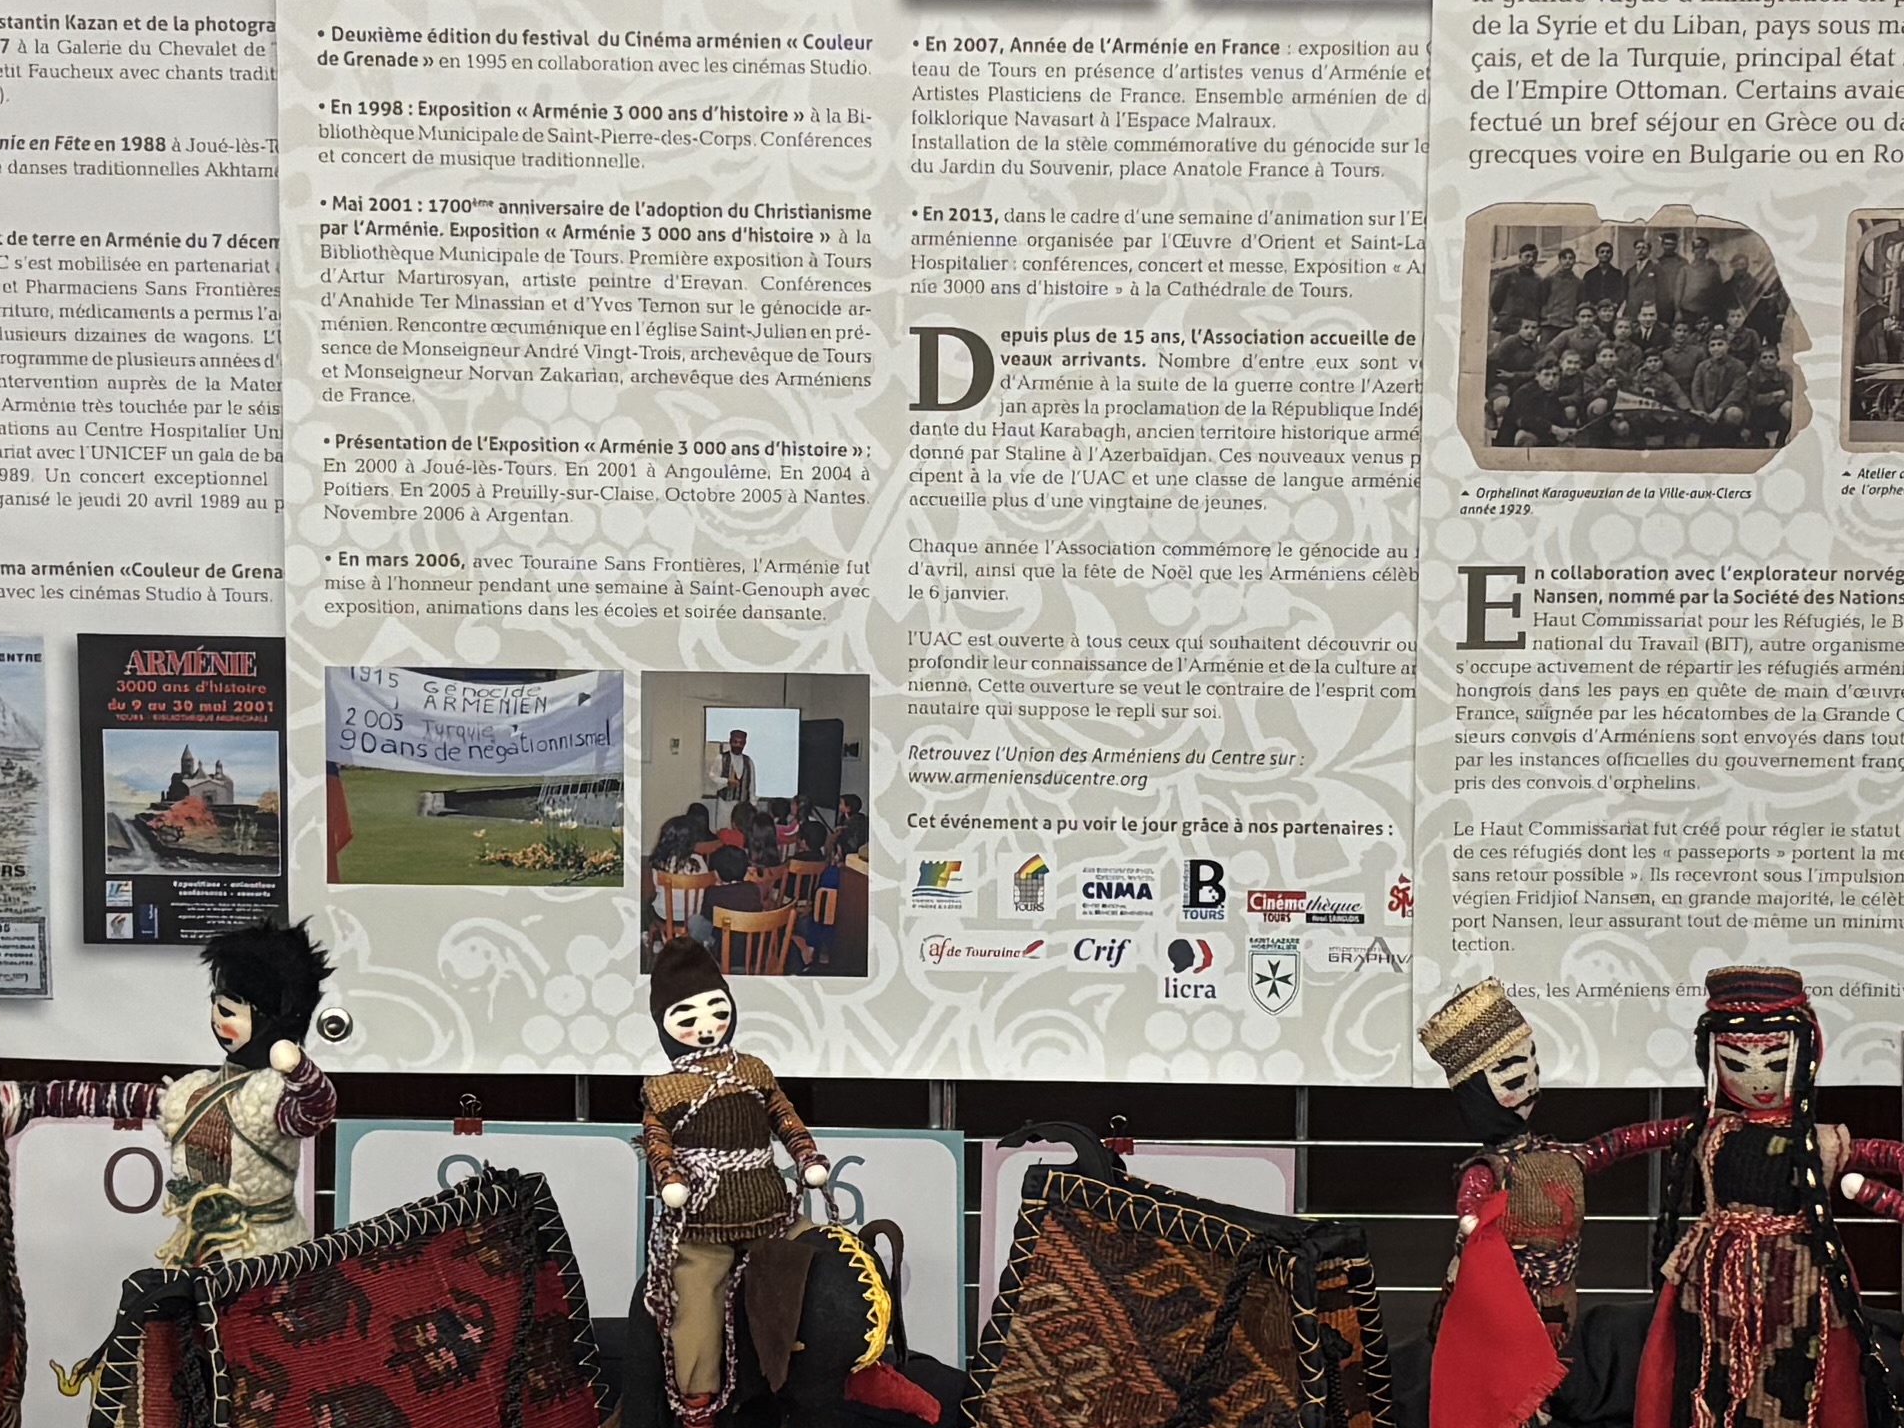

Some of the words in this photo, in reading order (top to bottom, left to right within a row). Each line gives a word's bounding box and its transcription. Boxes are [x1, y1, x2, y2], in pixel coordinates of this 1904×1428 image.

[125, 644, 258, 678] ARMÉNIE
[423, 680, 543, 699] Génocide
[423, 694, 547, 715] ARMENIEN
[339, 728, 377, 755] 90
[380, 736, 428, 759] ans
[434, 739, 462, 762] de
[1081, 881, 1154, 901] CNMA
[1073, 937, 1132, 969] Crif
[1164, 976, 1217, 1001] licra
